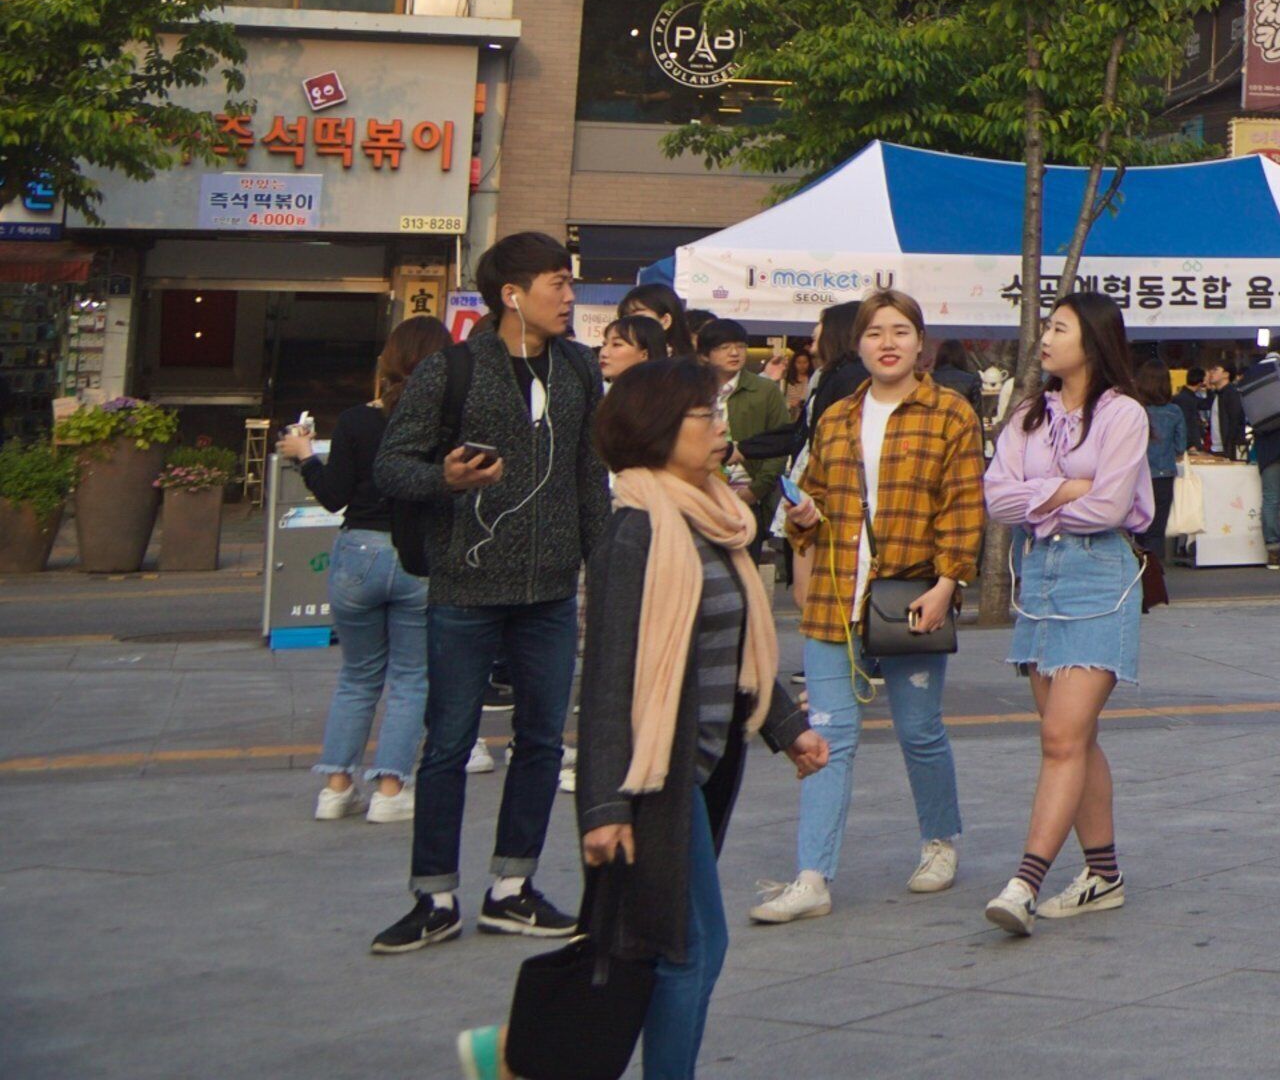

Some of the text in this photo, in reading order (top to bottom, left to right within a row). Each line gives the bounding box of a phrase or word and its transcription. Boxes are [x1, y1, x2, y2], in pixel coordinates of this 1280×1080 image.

[213, 114, 455, 172] 즉석떡볶이
[241, 178, 284, 190] 맛있는
[402, 217, 462, 230] 313-8288
[795, 293, 835, 303] SEOUL
